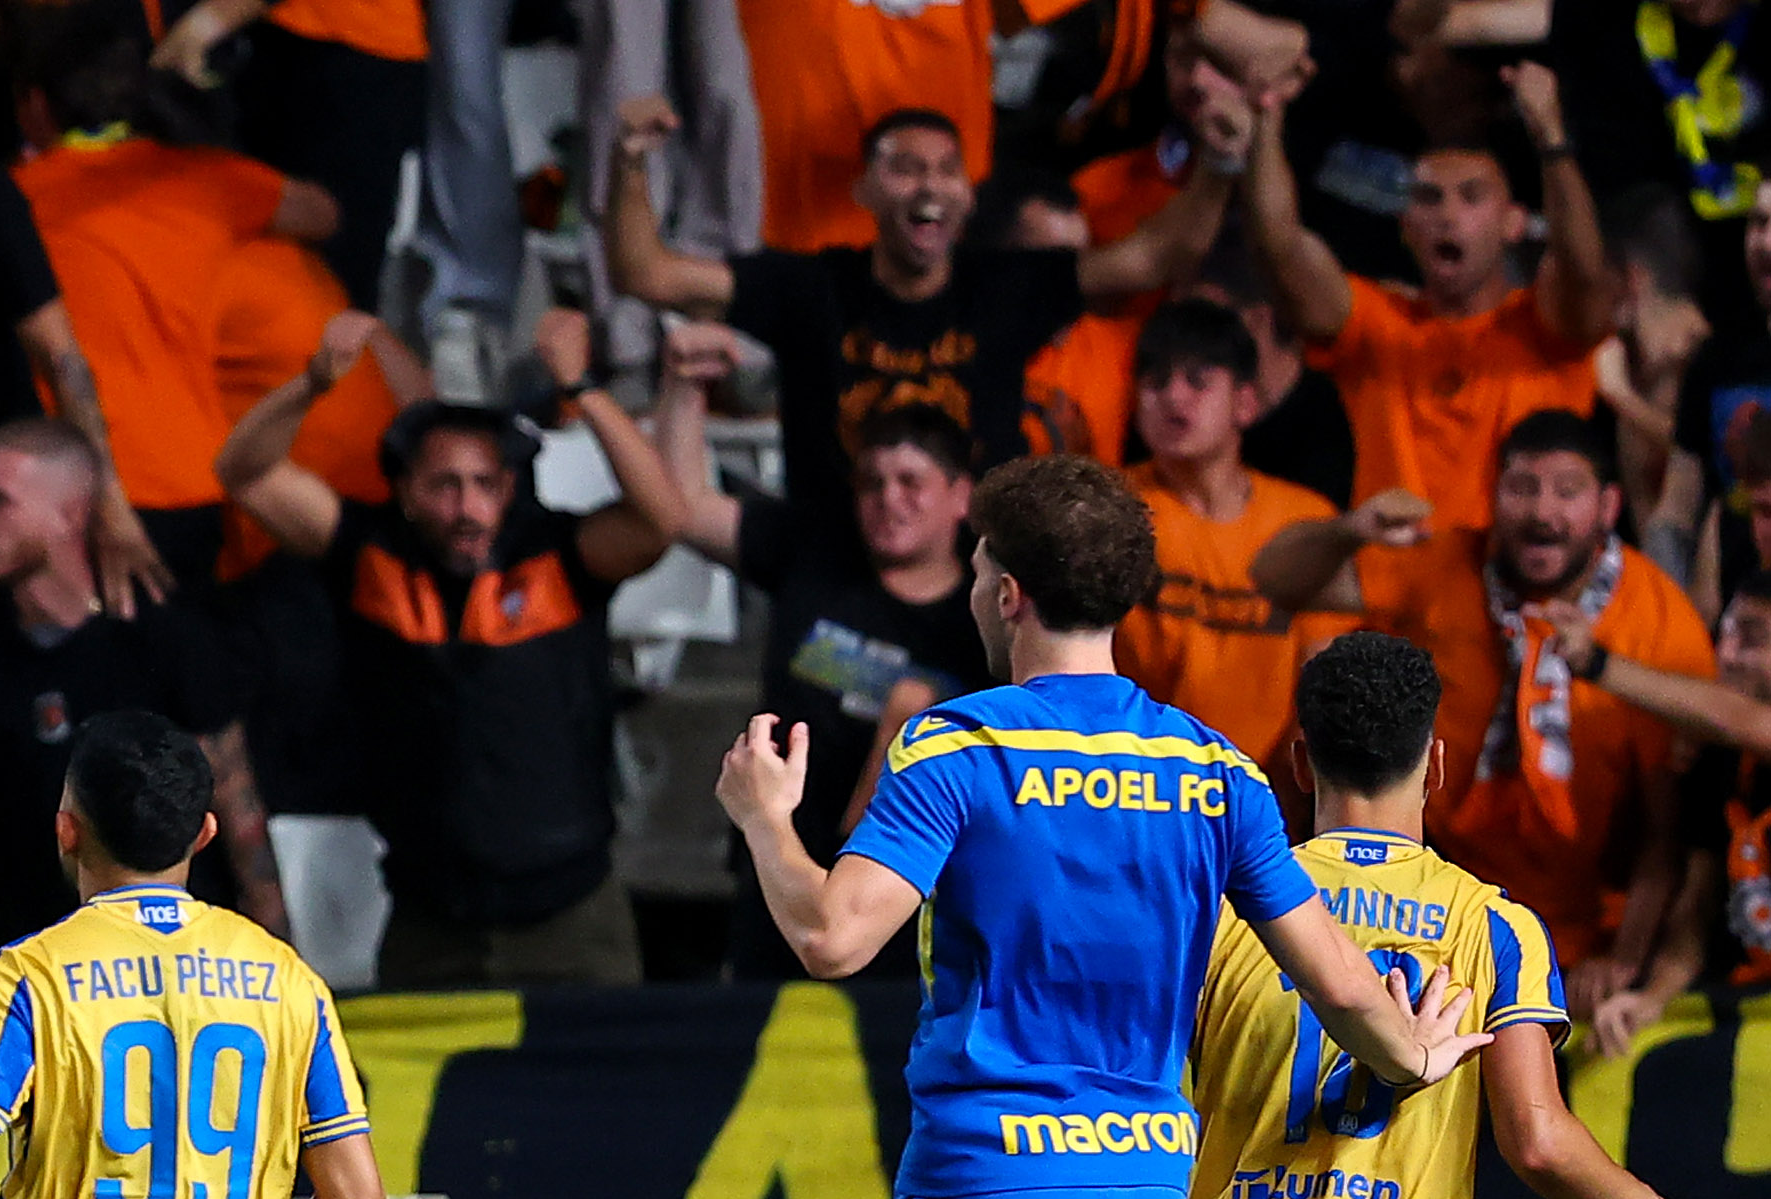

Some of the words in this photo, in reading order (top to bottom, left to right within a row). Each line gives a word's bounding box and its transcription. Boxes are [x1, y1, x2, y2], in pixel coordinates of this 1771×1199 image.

[1015, 766, 1171, 813] APOEL
[1178, 774, 1226, 817] FC
[62, 955, 164, 1002] FACU
[999, 1111, 1197, 1156] macron
